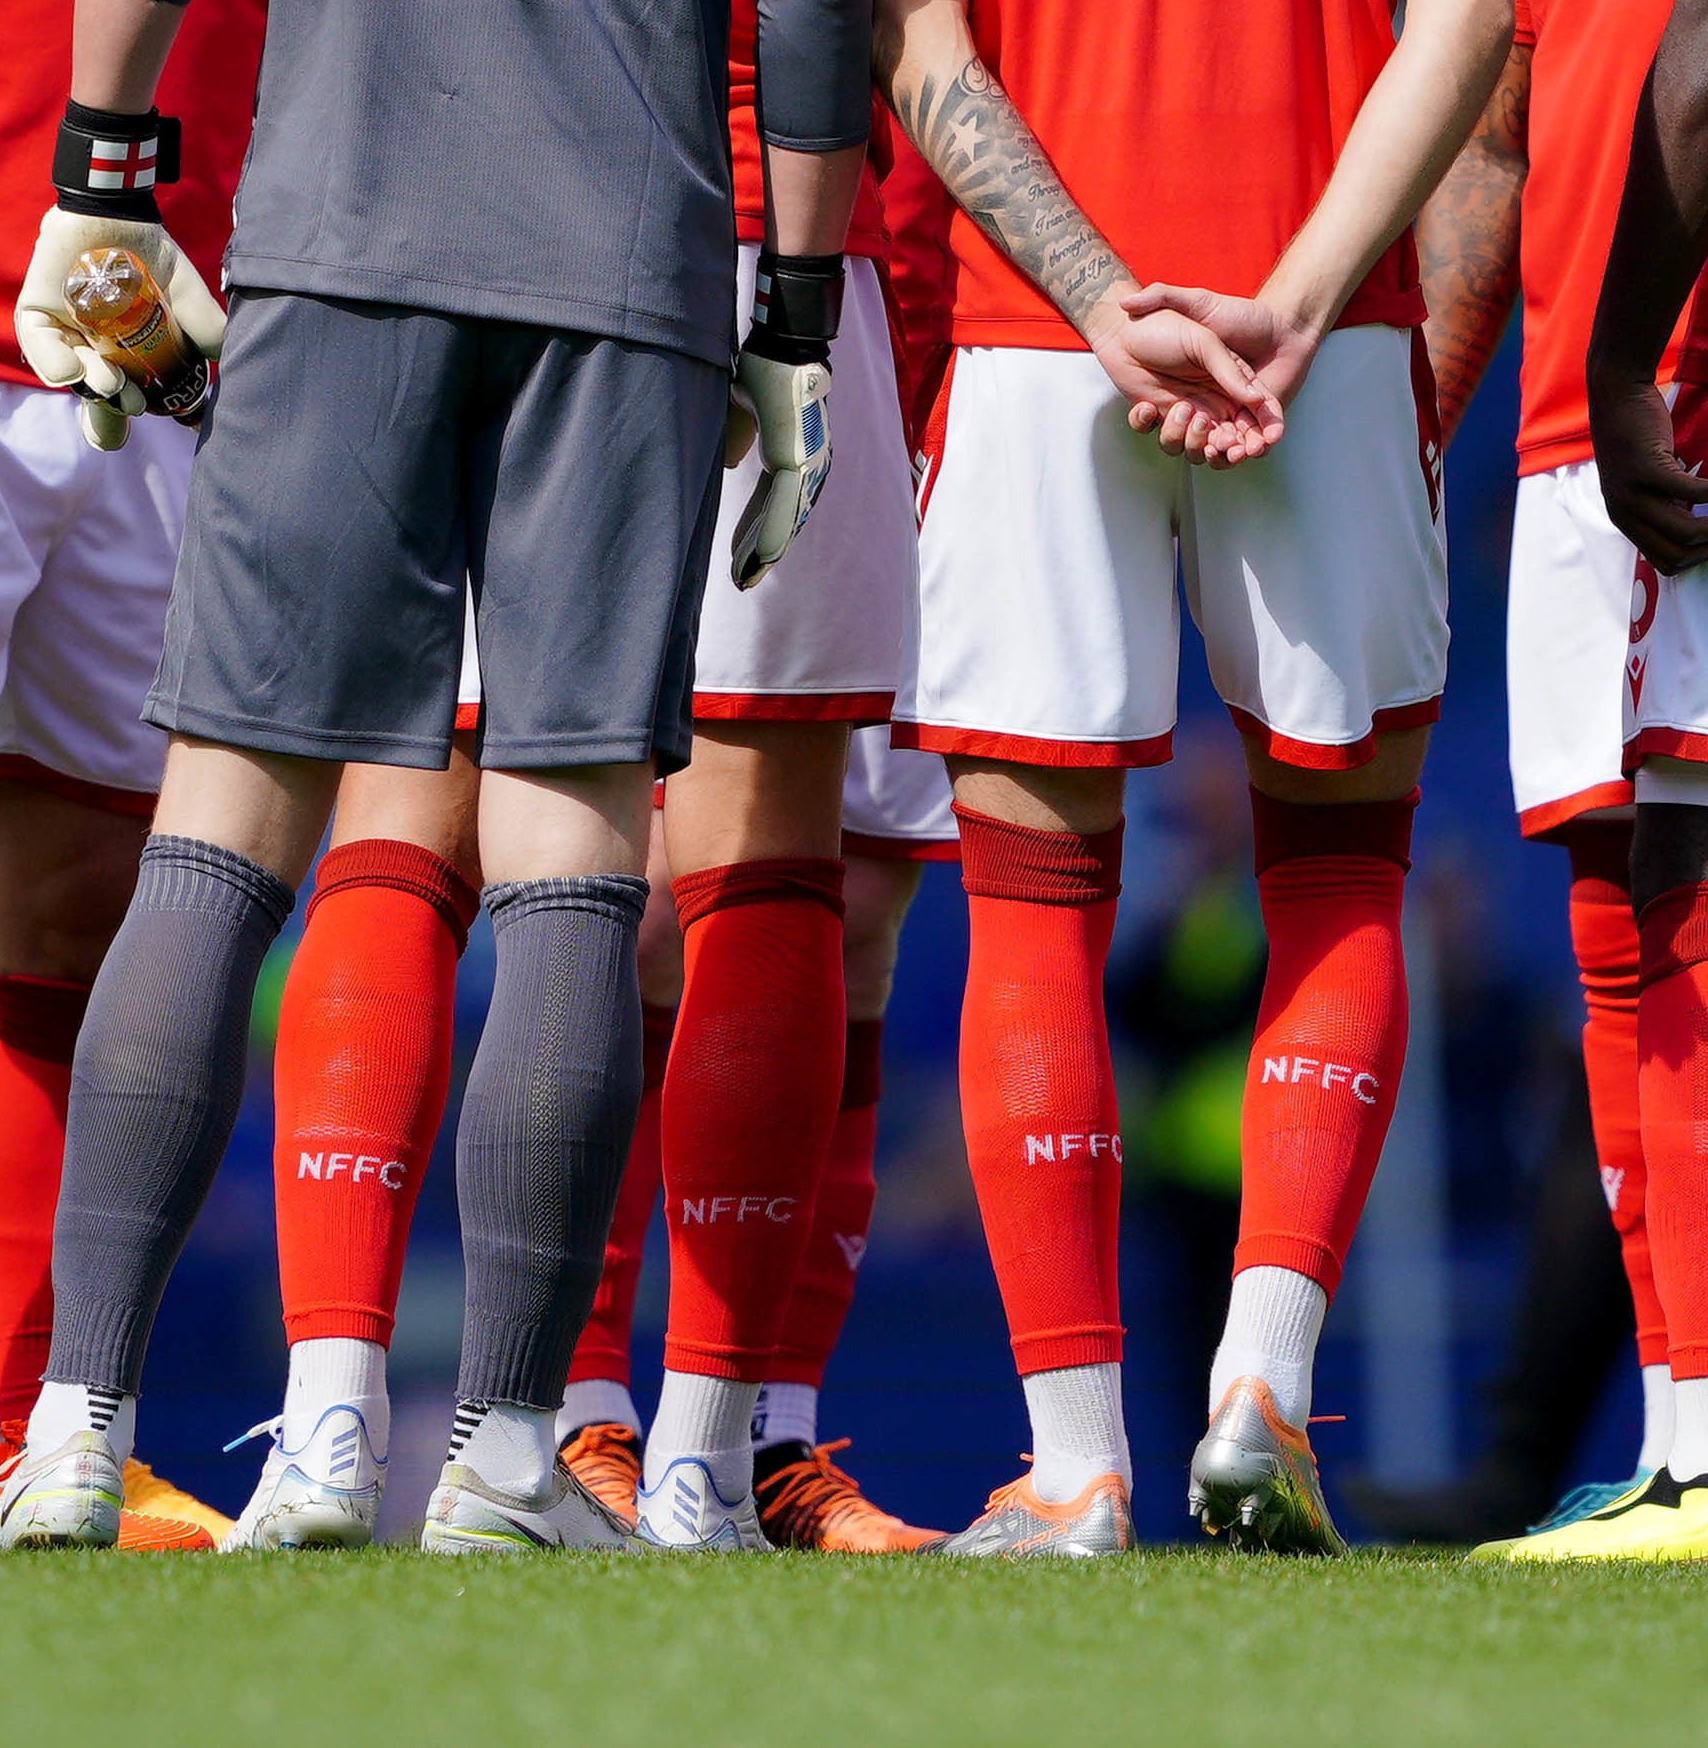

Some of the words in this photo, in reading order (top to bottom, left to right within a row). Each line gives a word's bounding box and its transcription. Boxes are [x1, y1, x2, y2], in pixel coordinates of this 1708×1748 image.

[1262, 1055, 1377, 1105] NFFC
[296, 1151, 408, 1191] NFFC
[681, 1194, 799, 1226] NFFC
